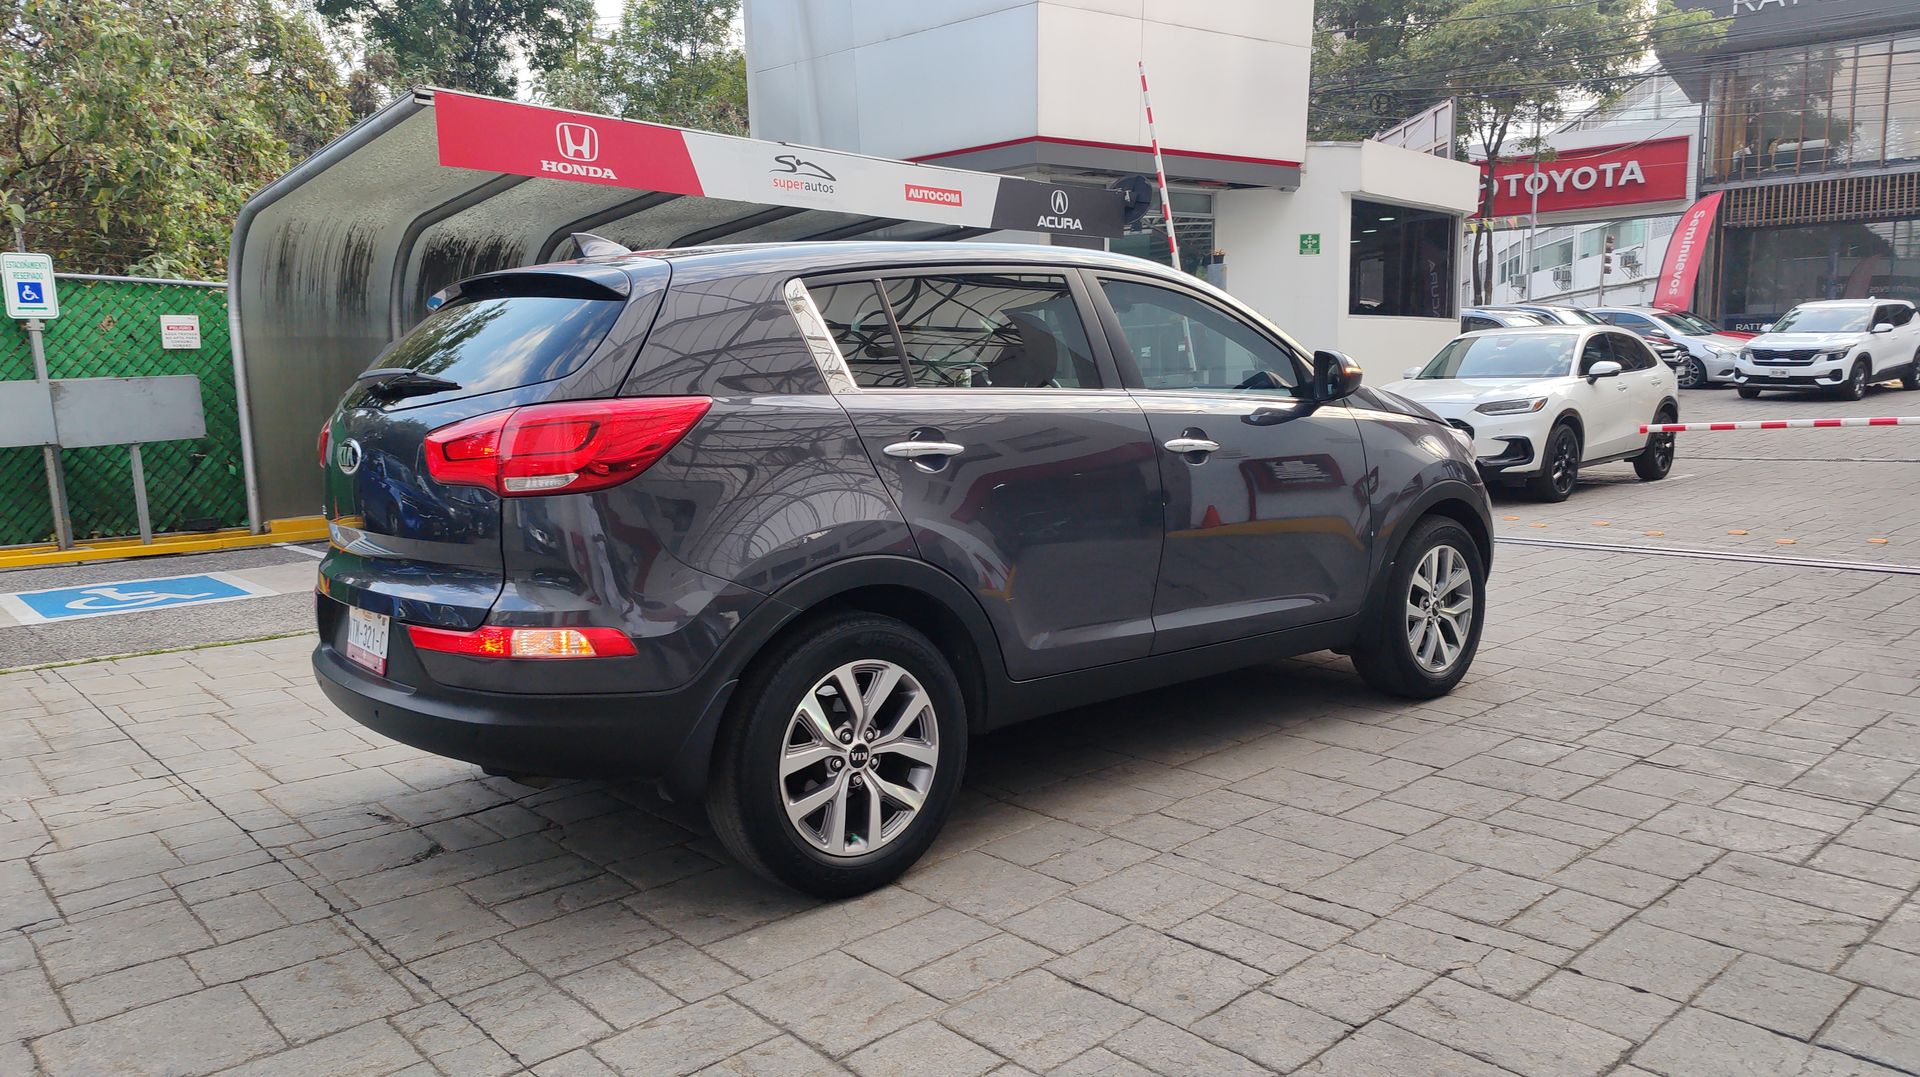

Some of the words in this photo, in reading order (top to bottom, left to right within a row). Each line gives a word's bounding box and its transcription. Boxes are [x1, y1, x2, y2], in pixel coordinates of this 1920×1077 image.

[540, 160, 618, 180] HONDA
[1503, 160, 1646, 197] TOYOTA
[773, 178, 834, 194] superautos
[908, 187, 960, 204] AUTOCOM
[1036, 215, 1083, 230] ACURA
[1669, 210, 1706, 296] Seminuevos
[851, 751, 868, 761] KIA
